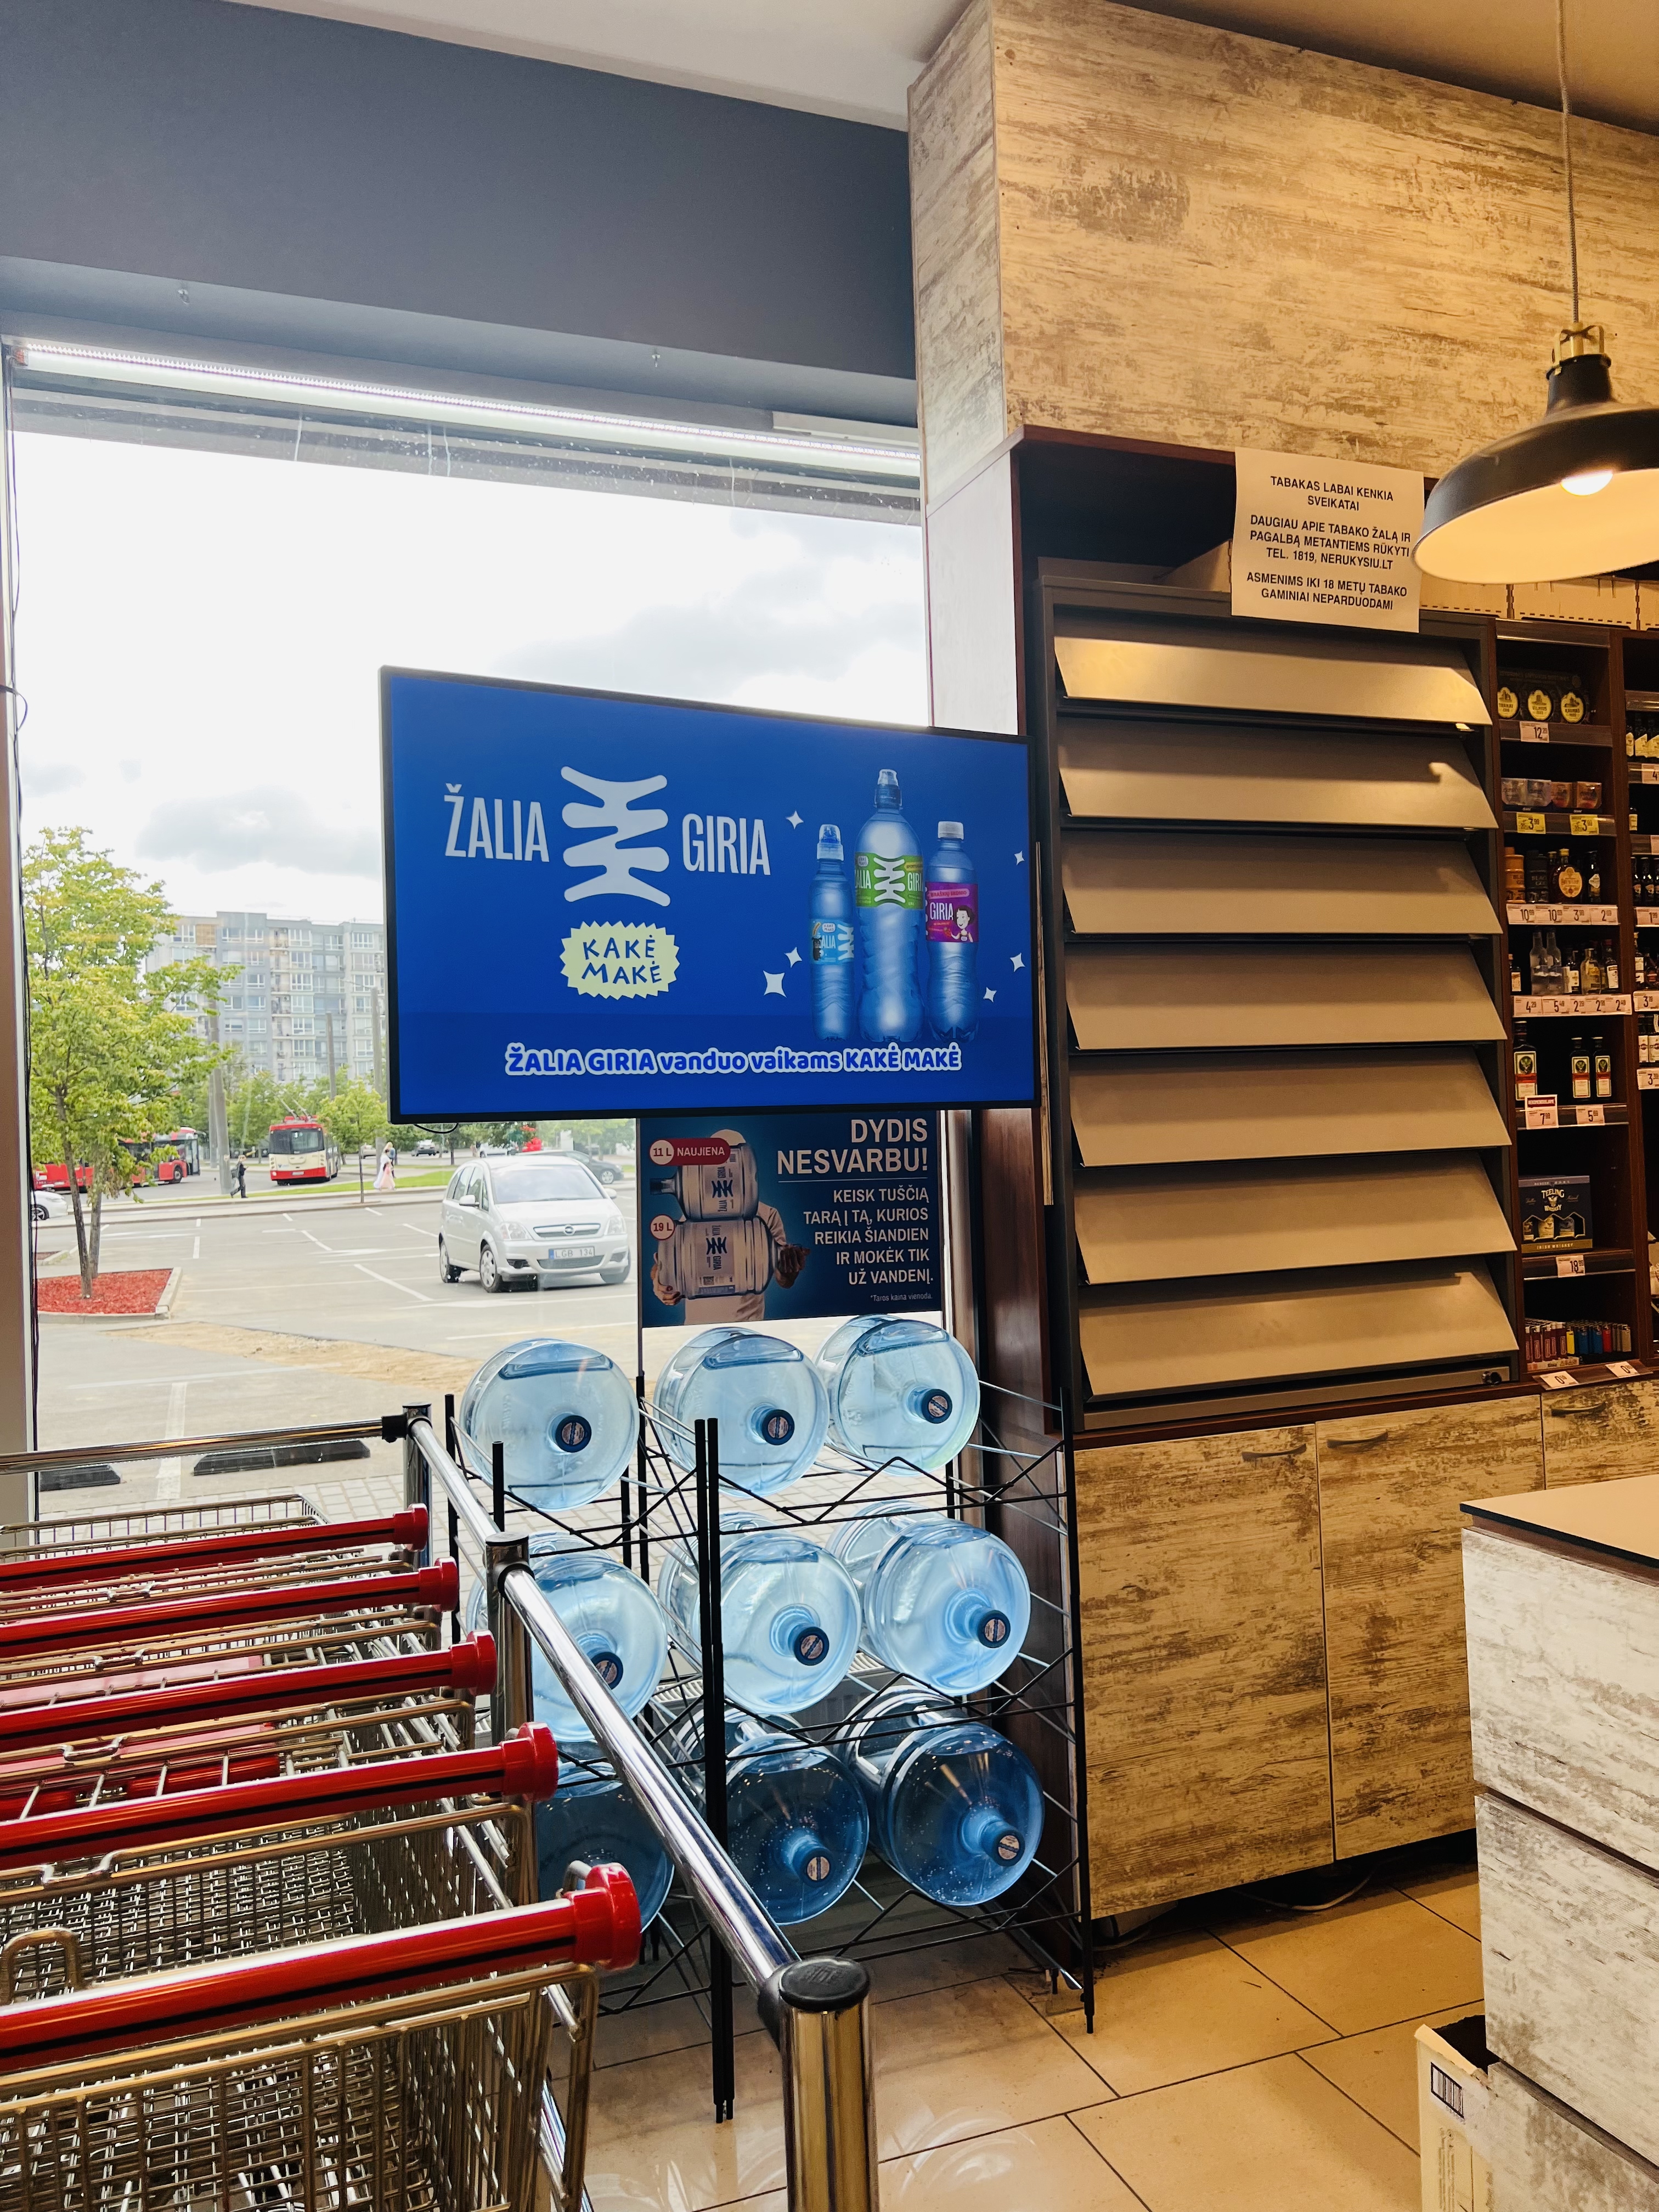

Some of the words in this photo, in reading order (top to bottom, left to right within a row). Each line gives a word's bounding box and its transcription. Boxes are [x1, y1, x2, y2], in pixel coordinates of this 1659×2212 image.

[1270, 476, 1320, 491] TABAKAS
[1323, 483, 1353, 495] LABAI
[1357, 487, 1393, 501] KENKIA
[1307, 495, 1359, 511] SVEIKATAI
[1250, 515, 1298, 529] DAUGIAU
[1301, 521, 1325, 532] APIE
[1328, 524, 1369, 537] TABAKO
[1372, 527, 1398, 544] ŽALĄ
[1401, 533, 1411, 542] IR
[1250, 531, 1300, 548] PAGALBĄ
[1304, 536, 1370, 552] METANTIEMS
[1373, 541, 1409, 557] RŪKYTI
[1266, 548, 1289, 559] TEL.
[1293, 551, 1317, 563] 1819,
[1321, 554, 1393, 569] NERUKYSIU.LT
[1247, 572, 1303, 586] ASMENIMS
[1307, 578, 1320, 587] IKI
[1323, 579, 1334, 589] 18
[1338, 580, 1365, 595] METŲ
[1369, 583, 1407, 596] TABAKO
[1261, 588, 1309, 602] GAMINIAI
[1313, 592, 1393, 610] NEPARDUODAMI
[1533, 727, 1542, 738] 12
[444, 783, 550, 862] ŽALIA
[682, 813, 771, 876] GIRIA
[1528, 818, 1534, 830] 3
[1581, 820, 1587, 831] 3
[855, 870, 872, 889] ALIA
[930, 902, 953, 921] GIRIA
[1520, 909, 1529, 921] 10
[1548, 909, 1557, 921] 10
[1573, 910, 1579, 921] 3
[1601, 910, 1606, 921] 2
[583, 935, 655, 960] KAKĖ
[582, 961, 663, 985] MAKĖ
[1526, 1001, 1531, 1013] 4
[1554, 1001, 1559, 1012] 5
[1573, 1001, 1579, 1012] 2
[1595, 1000, 1601, 1012] 2
[1616, 1000, 1621, 1011] 2
[1643, 996, 1649, 1008] 3
[507, 1045, 585, 1073] ŽALIA
[588, 1051, 656, 1072] GIRIA
[659, 1050, 747, 1071] vanduo
[751, 1049, 840, 1069] vaikams
[845, 1046, 899, 1068] KAKĖ
[905, 1046, 959, 1068] MAKĖ
[1540, 1113, 1545, 1125] 7
[1588, 1110, 1593, 1122] 5
[851, 1118, 928, 1143] DYDIS
[653, 1148, 664, 1156] 11
[666, 1147, 672, 1156] L
[677, 1147, 725, 1156] NAUJIENA
[777, 1147, 928, 1175] NESVARBU!
[833, 1189, 874, 1203] KEISK
[879, 1184, 929, 1203] TUŠČIĄ
[1542, 1188, 1565, 1199] TEELING
[803, 1210, 842, 1226] TARĄ
[844, 1210, 848, 1226] Į
[852, 1209, 873, 1226] TĄ,
[877, 1208, 928, 1222] KURIOS
[653, 1222, 664, 1232] 19
[666, 1222, 673, 1232] L
[815, 1230, 861, 1245] REIKIA
[865, 1227, 929, 1243] ŠIANDIEN
[555, 1250, 573, 1258] LGB
[836, 1251, 849, 1265] IR
[854, 1246, 904, 1264] MOKĖK
[908, 1248, 930, 1261] TIK
[713, 1255, 722, 1270] GIRIA
[1570, 1260, 1579, 1273] 18
[849, 1268, 867, 1285] UŽ
[870, 1268, 934, 1284] VANDENĮ.
